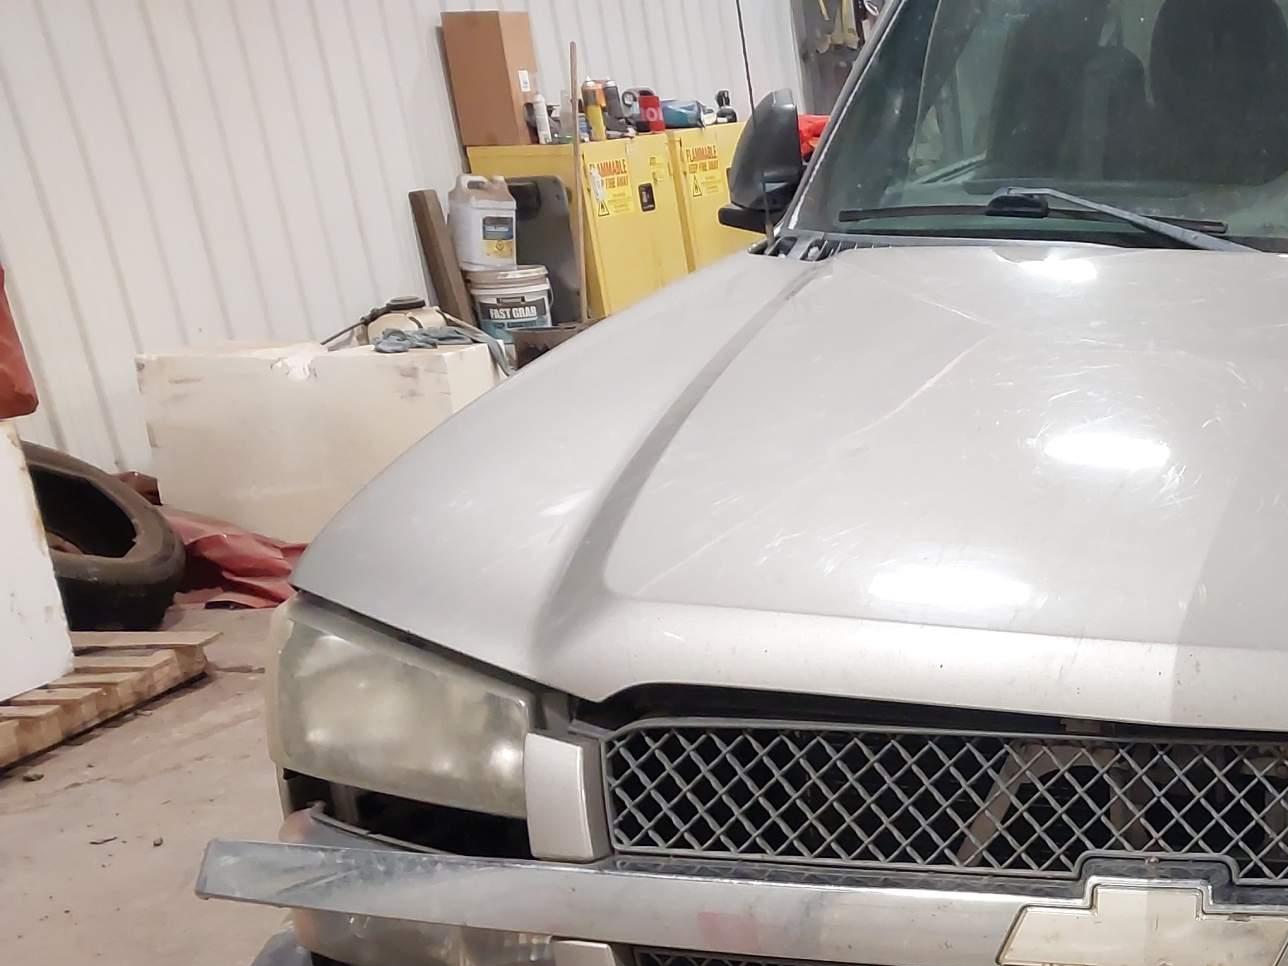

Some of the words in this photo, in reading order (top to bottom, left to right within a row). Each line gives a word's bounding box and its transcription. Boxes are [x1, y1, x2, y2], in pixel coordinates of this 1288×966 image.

[686, 145, 717, 162] FLAMMABLE
[489, 307, 511, 320] FAST
[511, 305, 537, 319] GRAB
